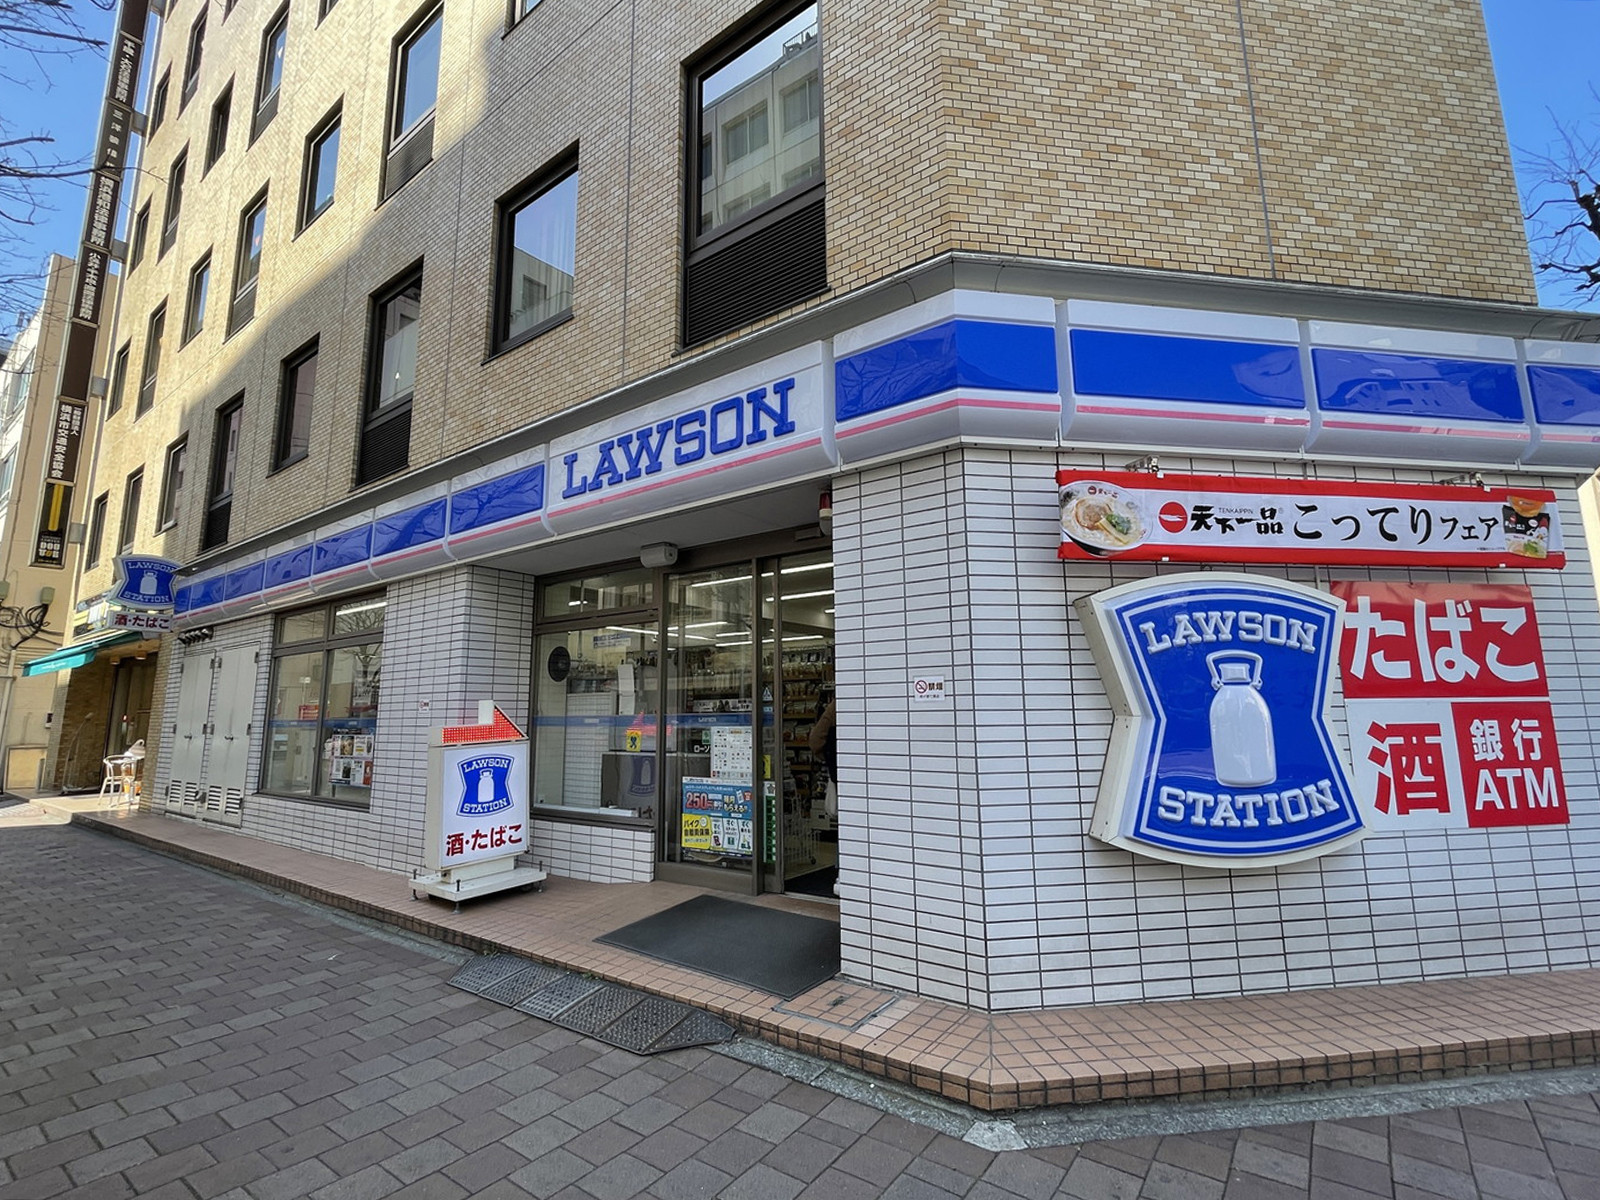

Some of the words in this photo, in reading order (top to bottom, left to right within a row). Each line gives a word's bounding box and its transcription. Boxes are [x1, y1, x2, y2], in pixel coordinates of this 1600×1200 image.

[562, 377, 796, 499] LAWSON
[1190, 505, 1284, 535] 天下一品
[123, 590, 170, 603] STATION
[114, 613, 170, 629] 酒・たばこ
[1138, 610, 1318, 655] LAWSON
[1344, 595, 1541, 683] たばこ
[1469, 717, 1543, 762] 銀行
[463, 758, 509, 773] LAWSON
[1366, 720, 1452, 816] 酒
[462, 797, 508, 813] STATION
[1157, 778, 1341, 828] STATION
[1474, 766, 1560, 812] ATM
[445, 823, 523, 857] 酒・たばこ
